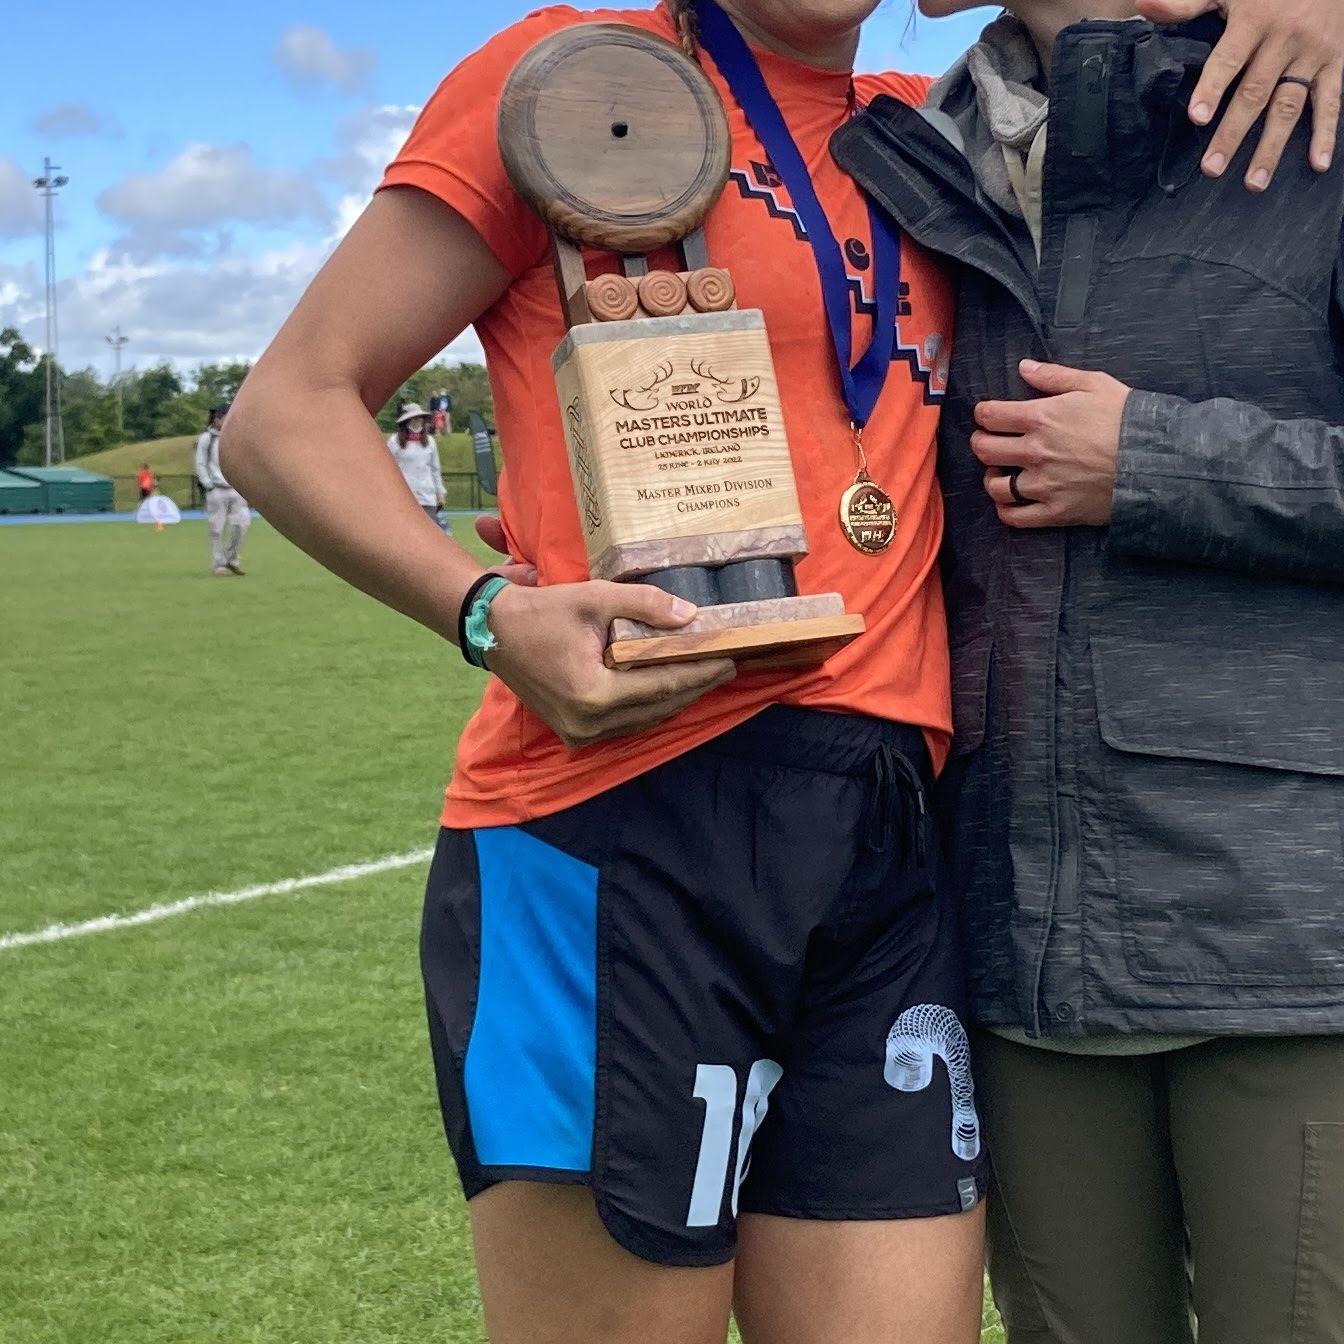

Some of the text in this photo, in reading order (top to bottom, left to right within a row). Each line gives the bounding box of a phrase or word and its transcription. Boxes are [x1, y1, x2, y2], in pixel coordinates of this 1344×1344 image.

[666, 396, 713, 412] WORLD
[615, 407, 768, 434] MASTERS ULTIMATE
[619, 425, 770, 450] CLUB CHAMPIONSHIPS
